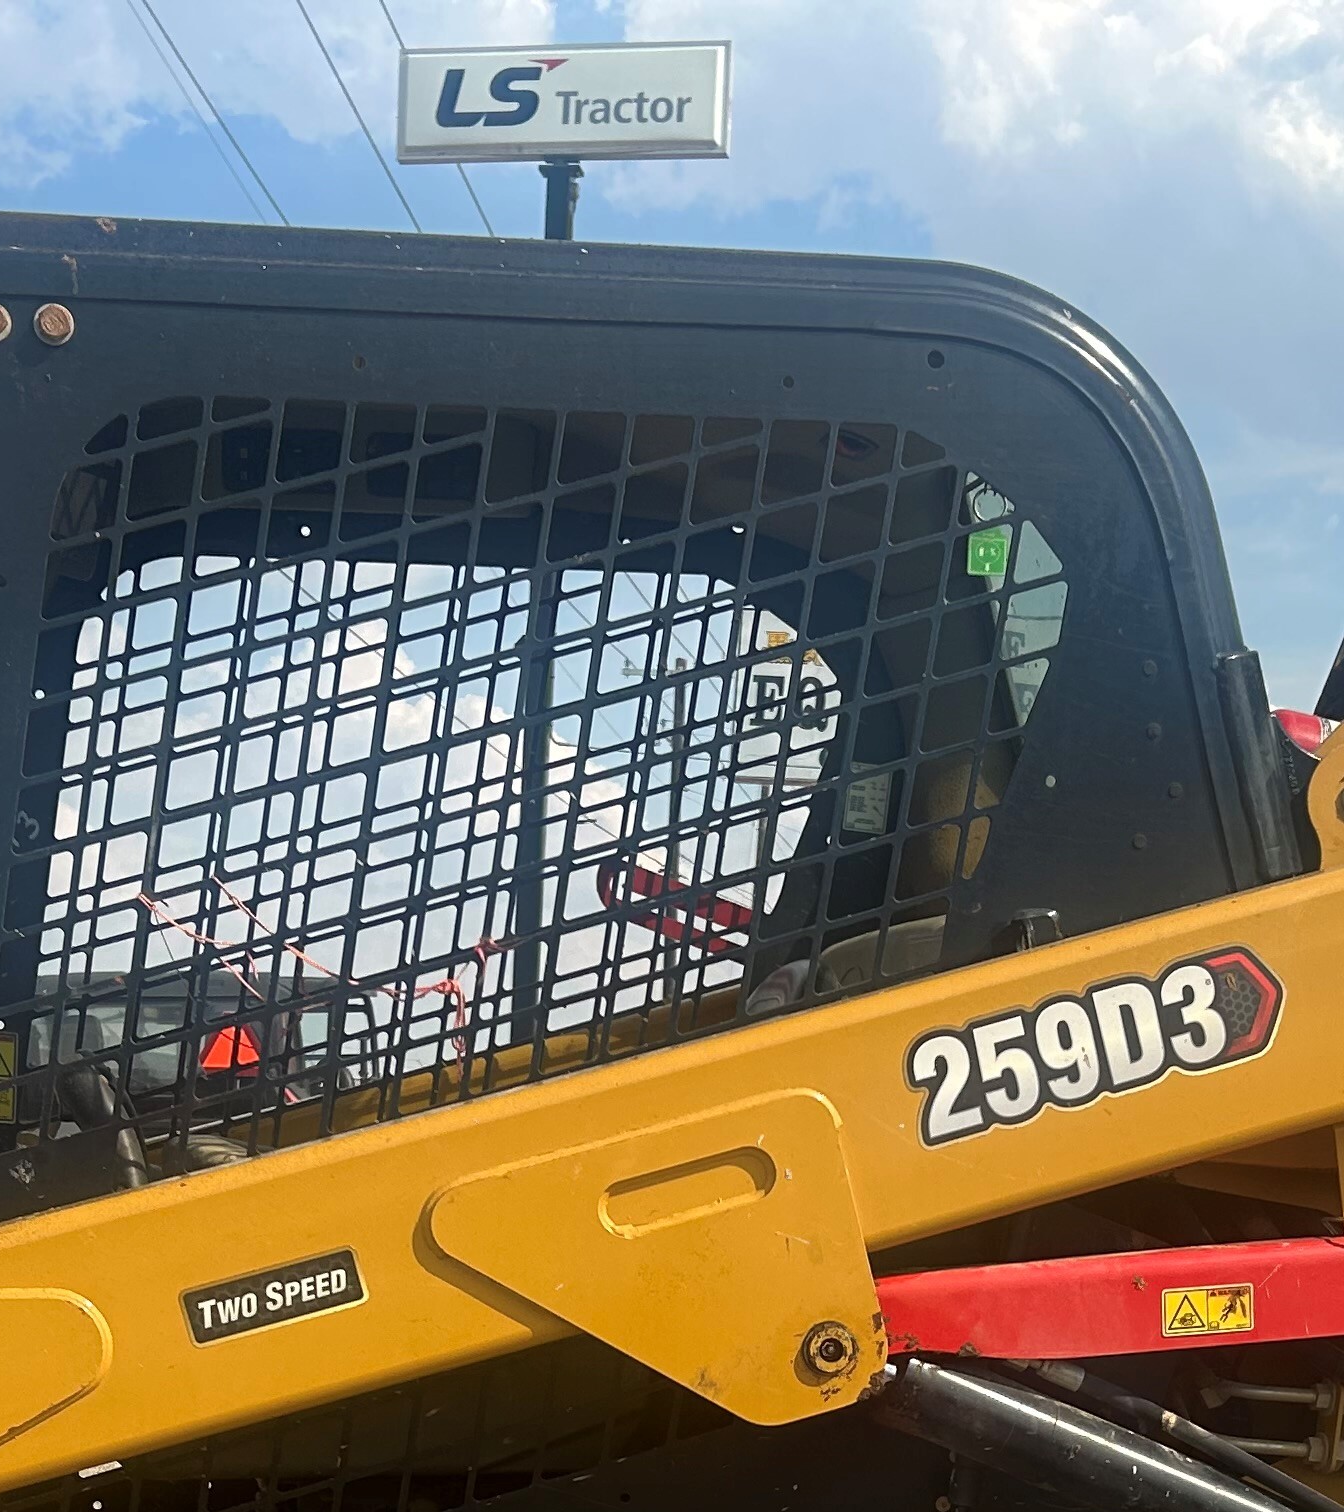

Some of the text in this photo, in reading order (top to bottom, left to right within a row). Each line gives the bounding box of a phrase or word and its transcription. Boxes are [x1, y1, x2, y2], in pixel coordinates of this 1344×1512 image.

[436, 66, 693, 128] LS Tractor
[912, 964, 1227, 1140] 259D3
[197, 1268, 347, 1329] TWO SPEED
